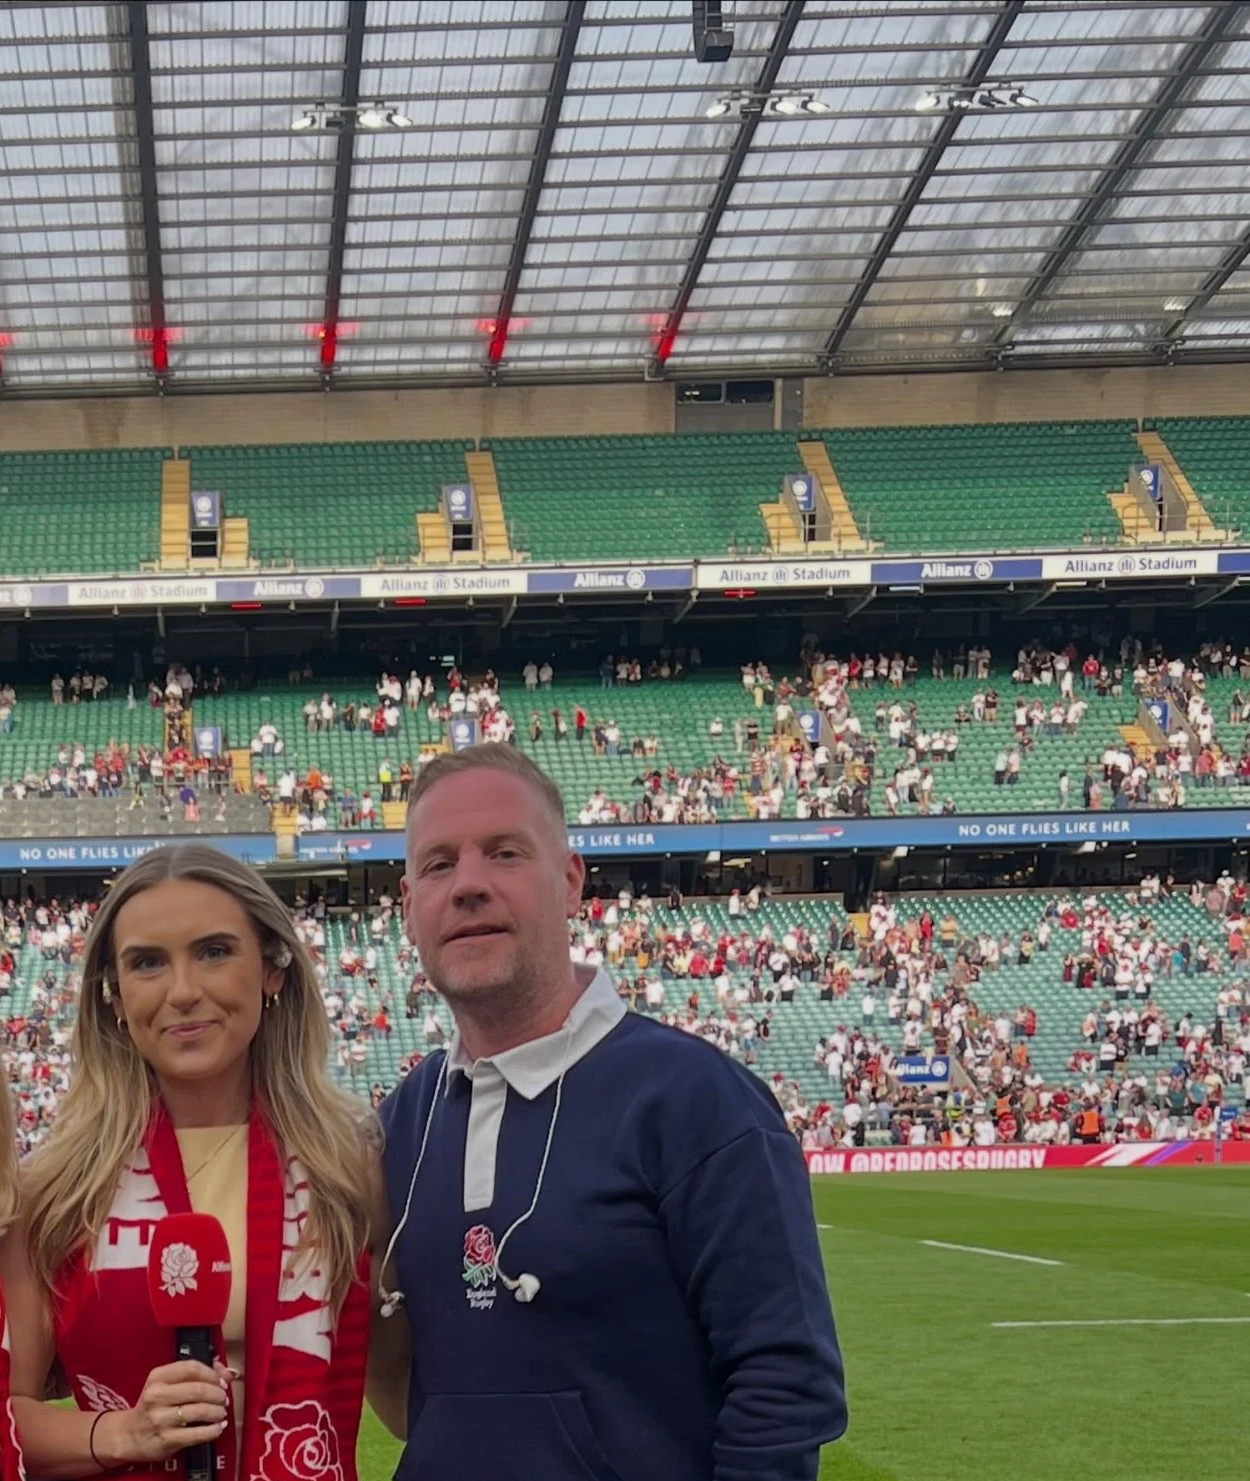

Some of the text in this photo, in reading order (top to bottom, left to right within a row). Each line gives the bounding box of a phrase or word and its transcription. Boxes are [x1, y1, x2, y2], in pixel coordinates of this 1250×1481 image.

[921, 563, 971, 578] Allianz
[1065, 557, 1197, 573] Allianz Stadium
[573, 572, 624, 588] Allianz
[719, 567, 850, 583] Allianz Stadium
[253, 580, 303, 595] Allianz
[381, 577, 510, 591] Allianz Stadium
[78, 585, 208, 599] Allianz Stadium
[959, 821, 1130, 836] NO ONE FLIES LIKE HER
[590, 834, 621, 846] LIKE
[627, 833, 655, 845] HER
[20, 848, 40, 860] NO
[47, 848, 76, 860] ONE
[81, 847, 118, 859] FLIES
